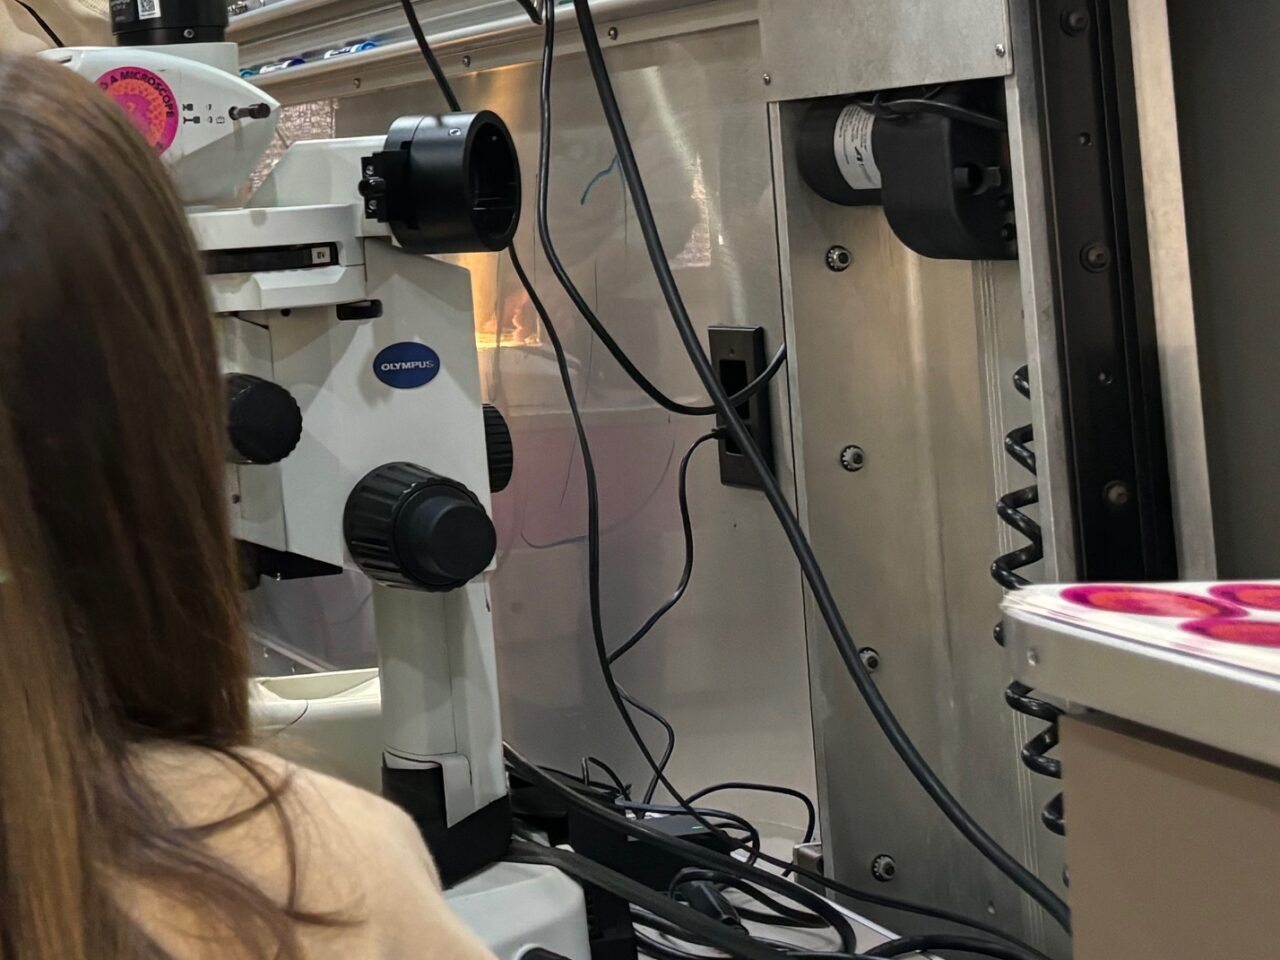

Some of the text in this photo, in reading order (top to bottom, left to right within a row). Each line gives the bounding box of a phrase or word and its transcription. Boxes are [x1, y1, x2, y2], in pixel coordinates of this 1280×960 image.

[110, 71, 175, 118] A MICROSCOPE
[380, 360, 434, 371] OLYMPUS
